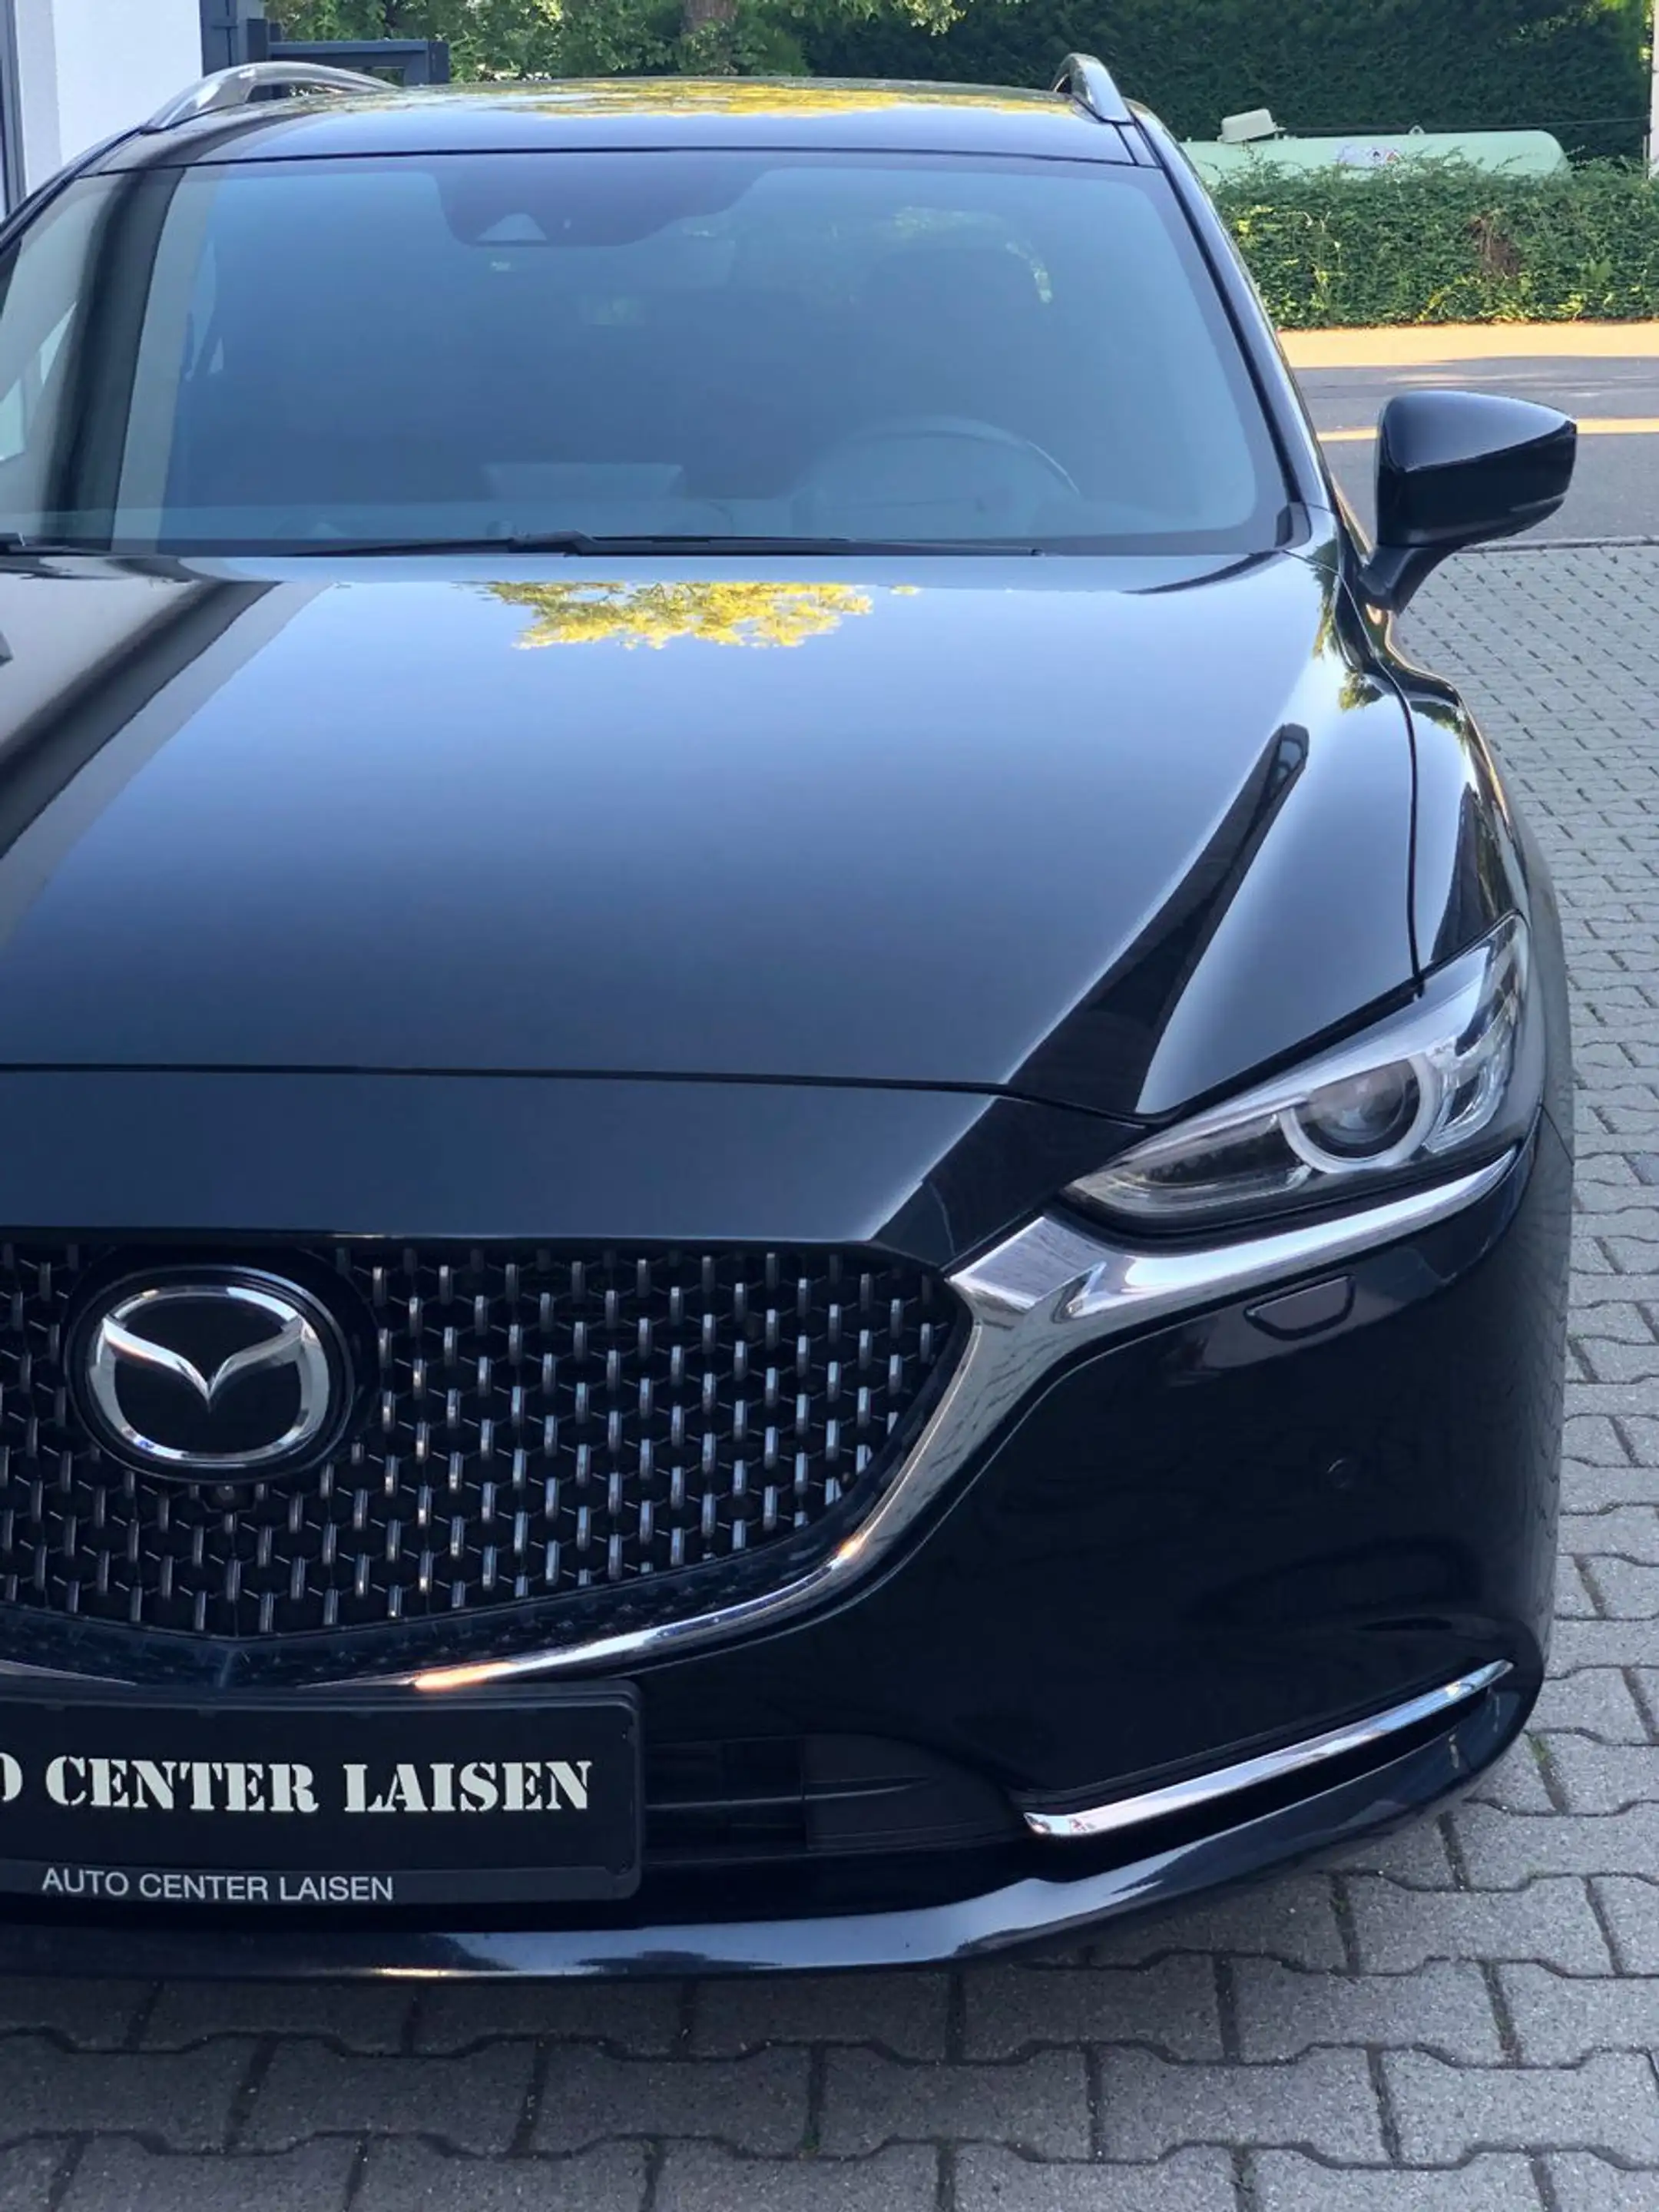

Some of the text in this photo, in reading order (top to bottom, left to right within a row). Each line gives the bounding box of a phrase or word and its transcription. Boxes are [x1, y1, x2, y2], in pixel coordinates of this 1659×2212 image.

[45, 1756, 320, 1813] CENTER
[343, 1760, 593, 1813] LAISEN
[41, 1866, 393, 1902] AUTO CENTER LAISEN
